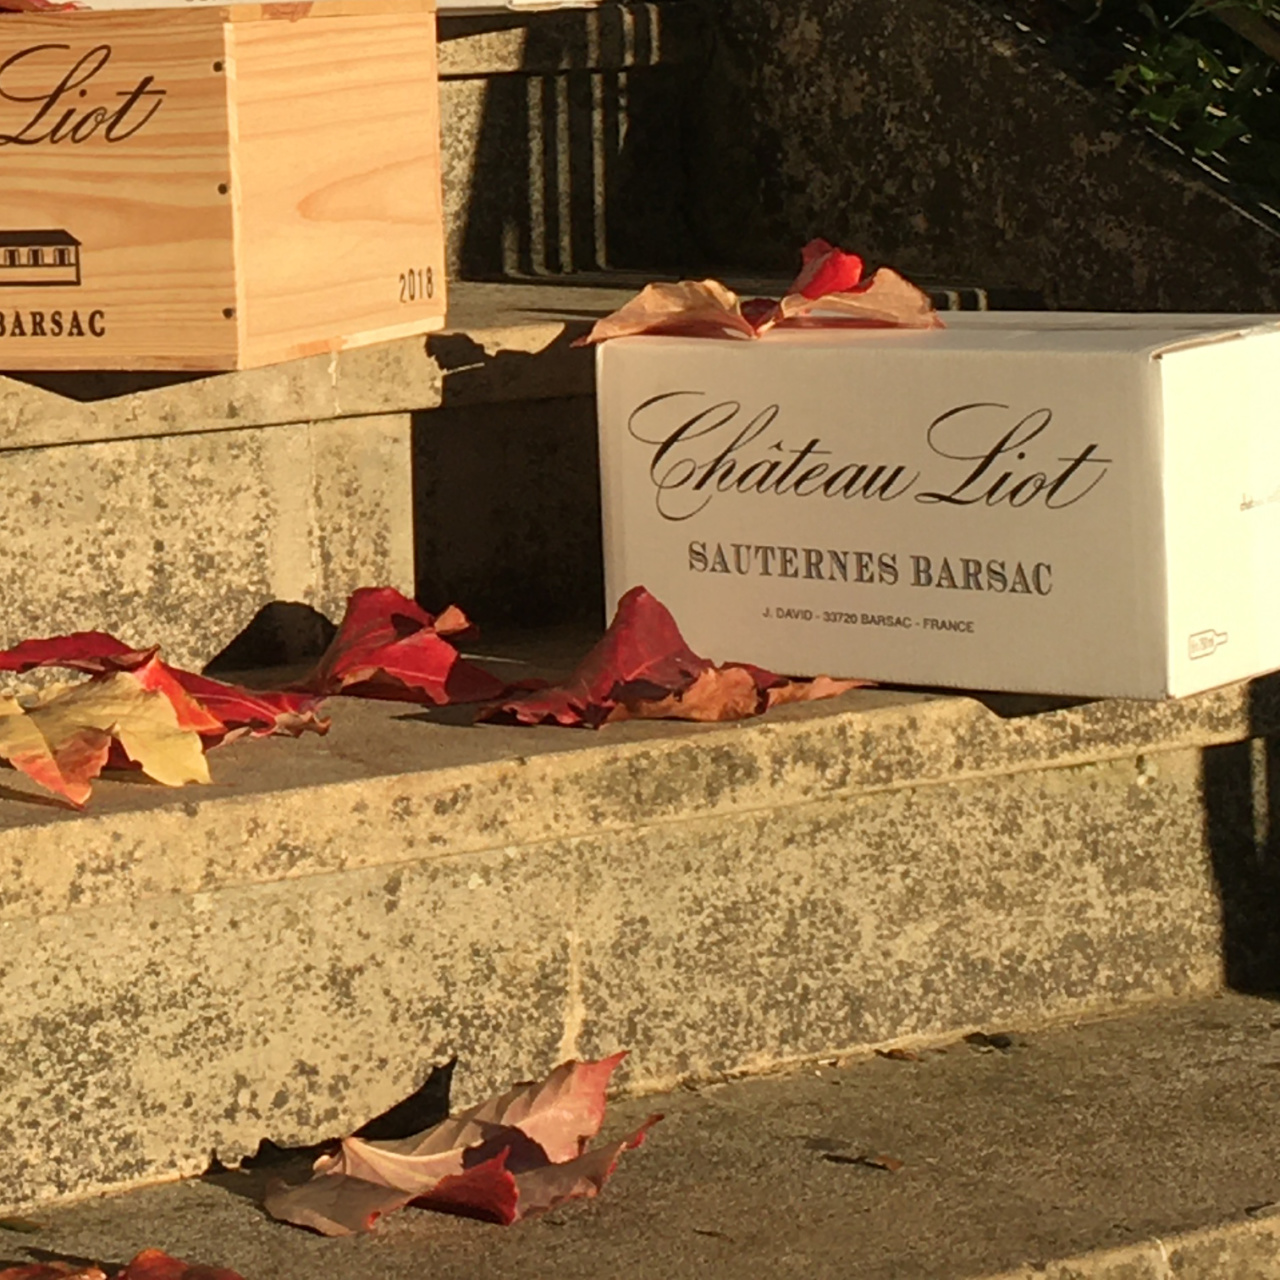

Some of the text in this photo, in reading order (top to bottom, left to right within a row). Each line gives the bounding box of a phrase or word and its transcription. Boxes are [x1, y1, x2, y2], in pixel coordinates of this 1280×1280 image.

[398, 265, 434, 304] 2018
[627, 391, 1113, 522] Château Liot
[688, 540, 1053, 597] SAUTERNES BARSAC
[775, 607, 813, 621] DAVID
[822, 610, 858, 625] 33720
[860, 612, 912, 629] BARSAC
[922, 617, 975, 634] FRANCE
